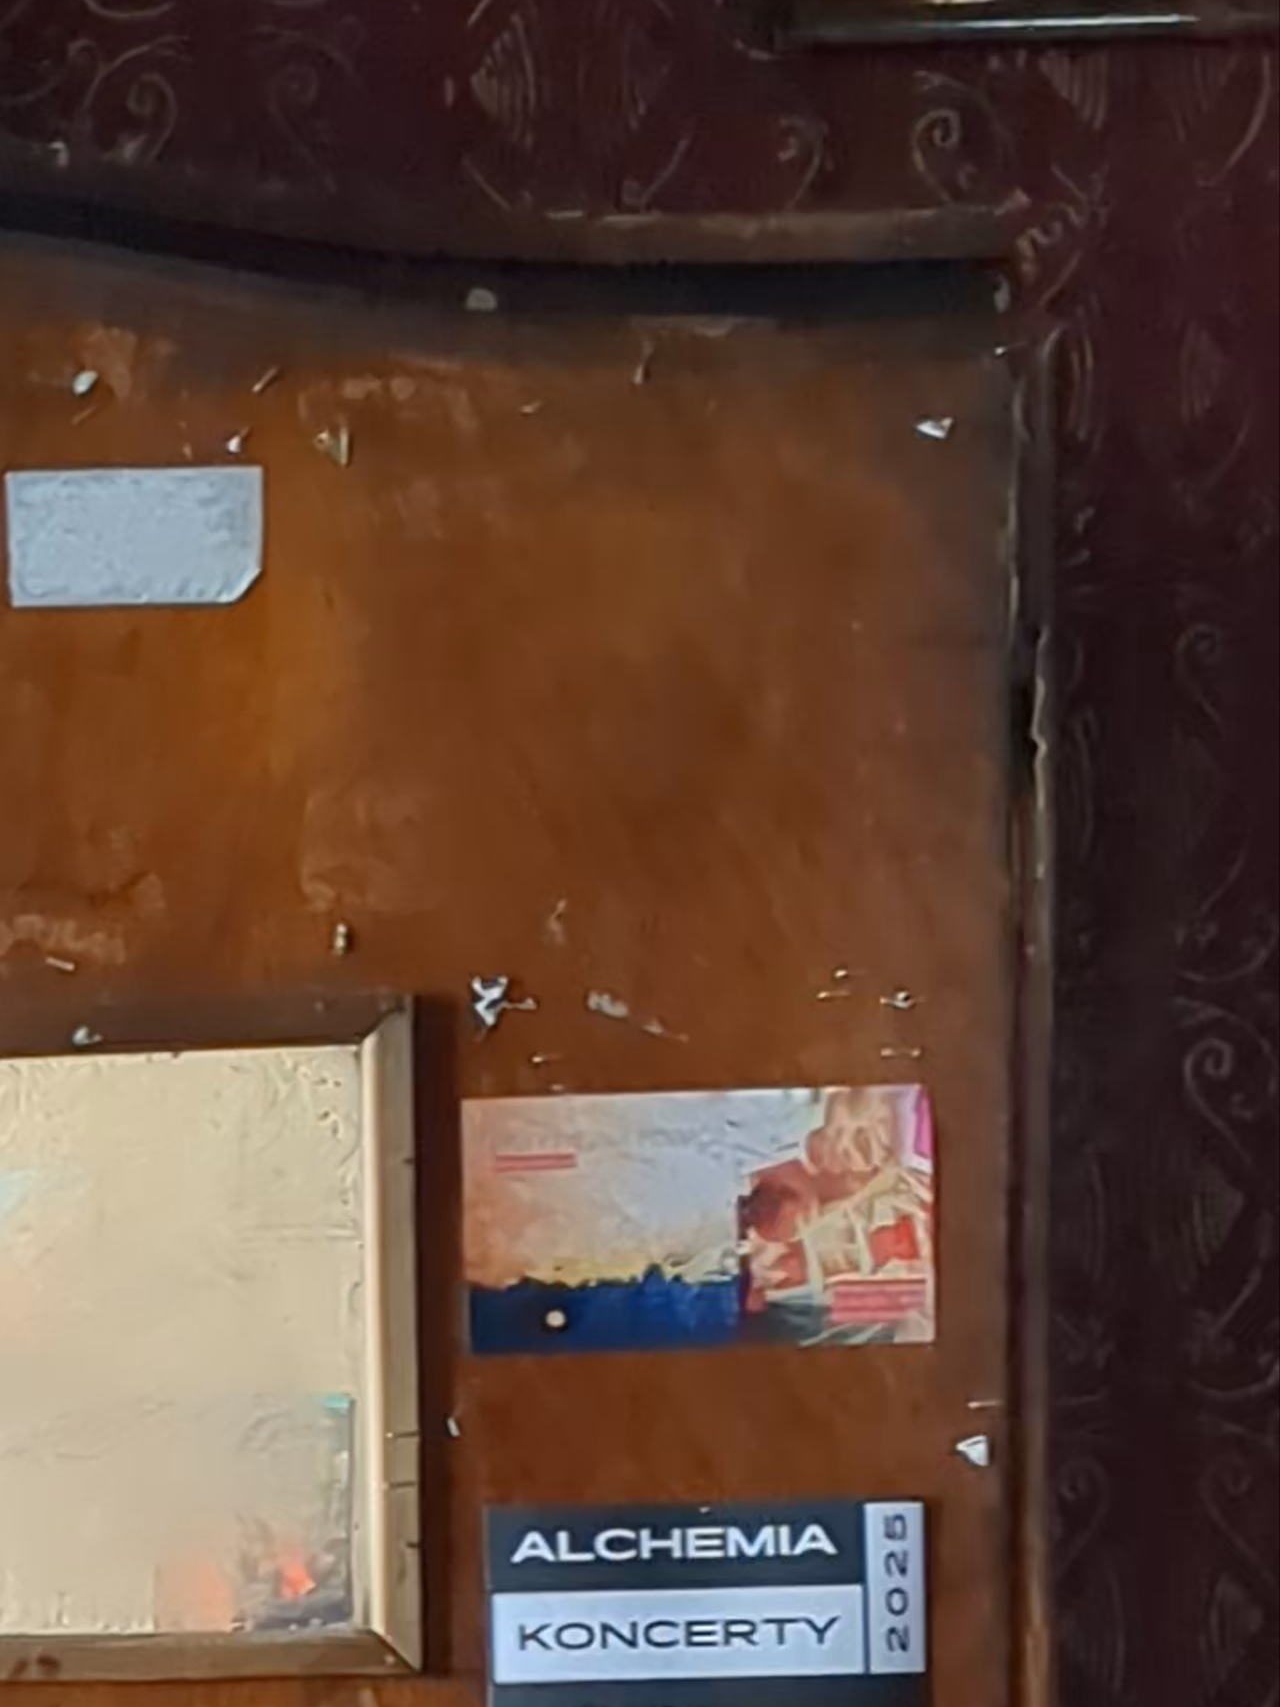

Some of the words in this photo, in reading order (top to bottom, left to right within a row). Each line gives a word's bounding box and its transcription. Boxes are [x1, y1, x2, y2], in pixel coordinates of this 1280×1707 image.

[510, 1524, 838, 1563] ALCHEMIA
[884, 1513, 909, 1654] 2025
[519, 1615, 842, 1651] KONCERTY
